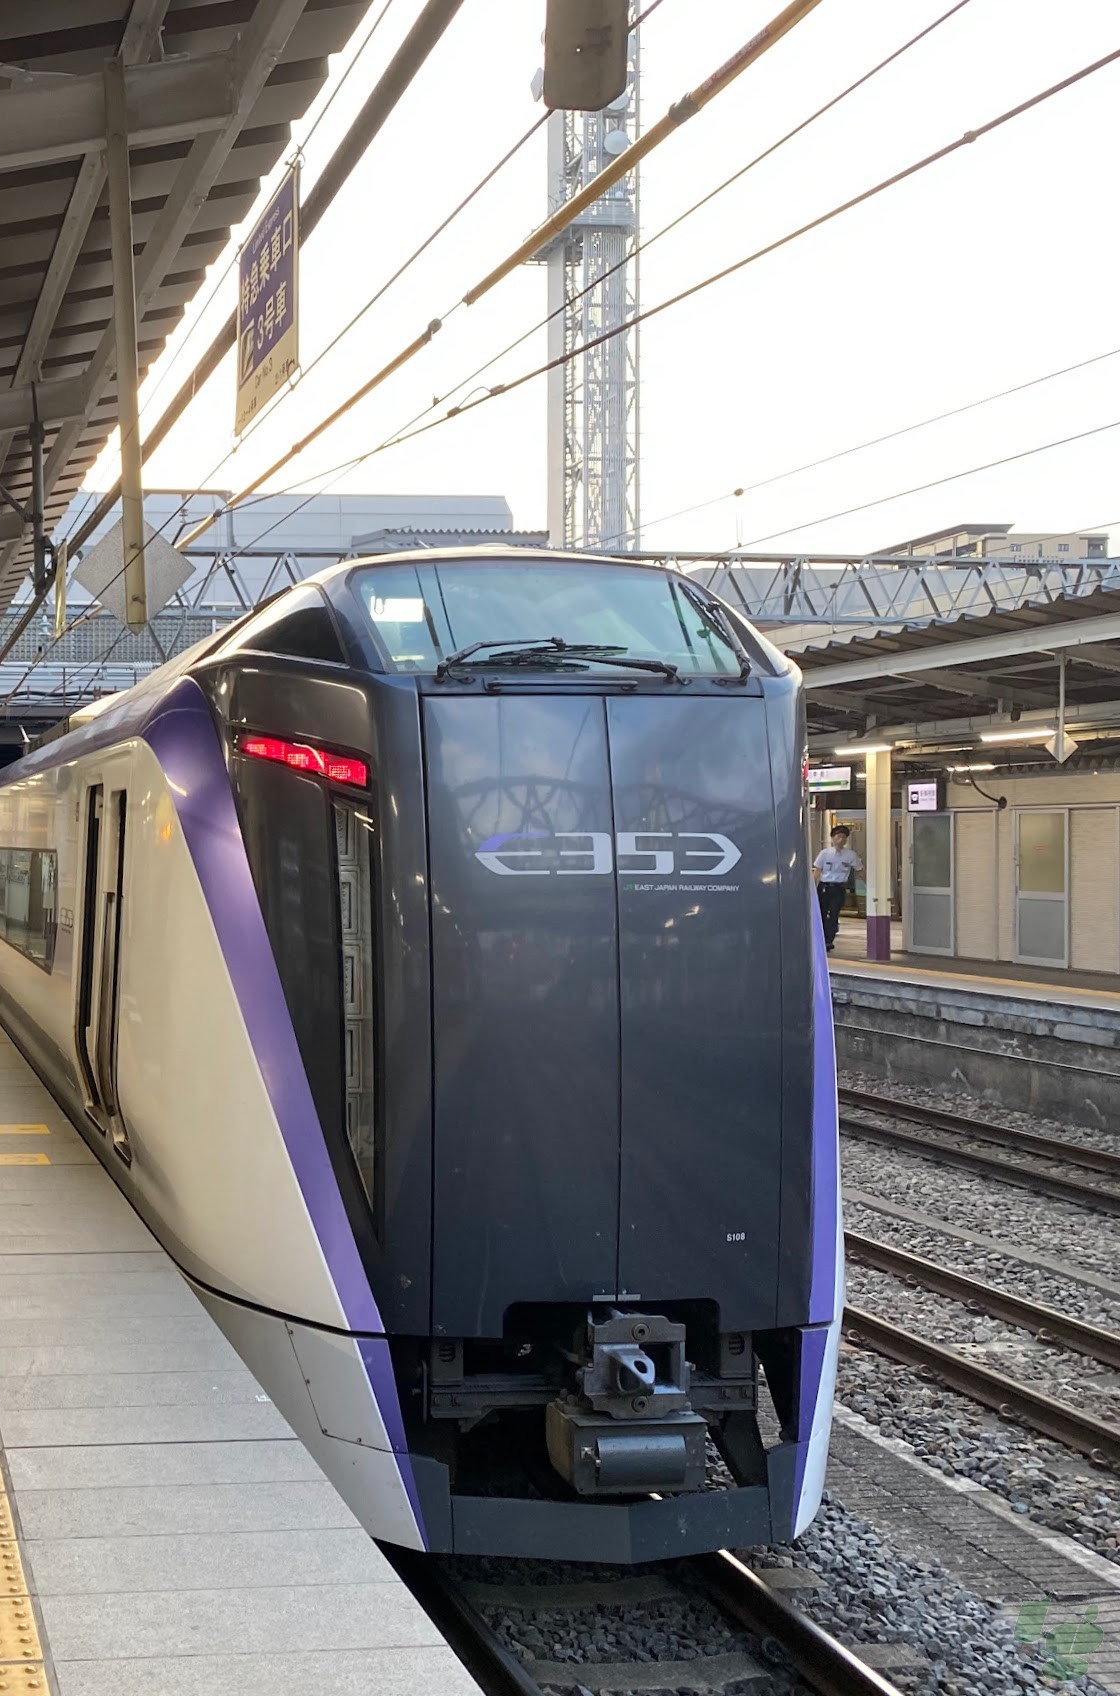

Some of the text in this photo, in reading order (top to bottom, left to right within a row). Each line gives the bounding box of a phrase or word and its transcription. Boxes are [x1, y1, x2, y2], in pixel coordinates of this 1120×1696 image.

[240, 209, 293, 319] 特急乗車口
[257, 280, 287, 351] 3号車
[475, 832, 742, 876] E353
[707, 884, 740, 892] COMPANY
[726, 1232, 746, 1242] S108
